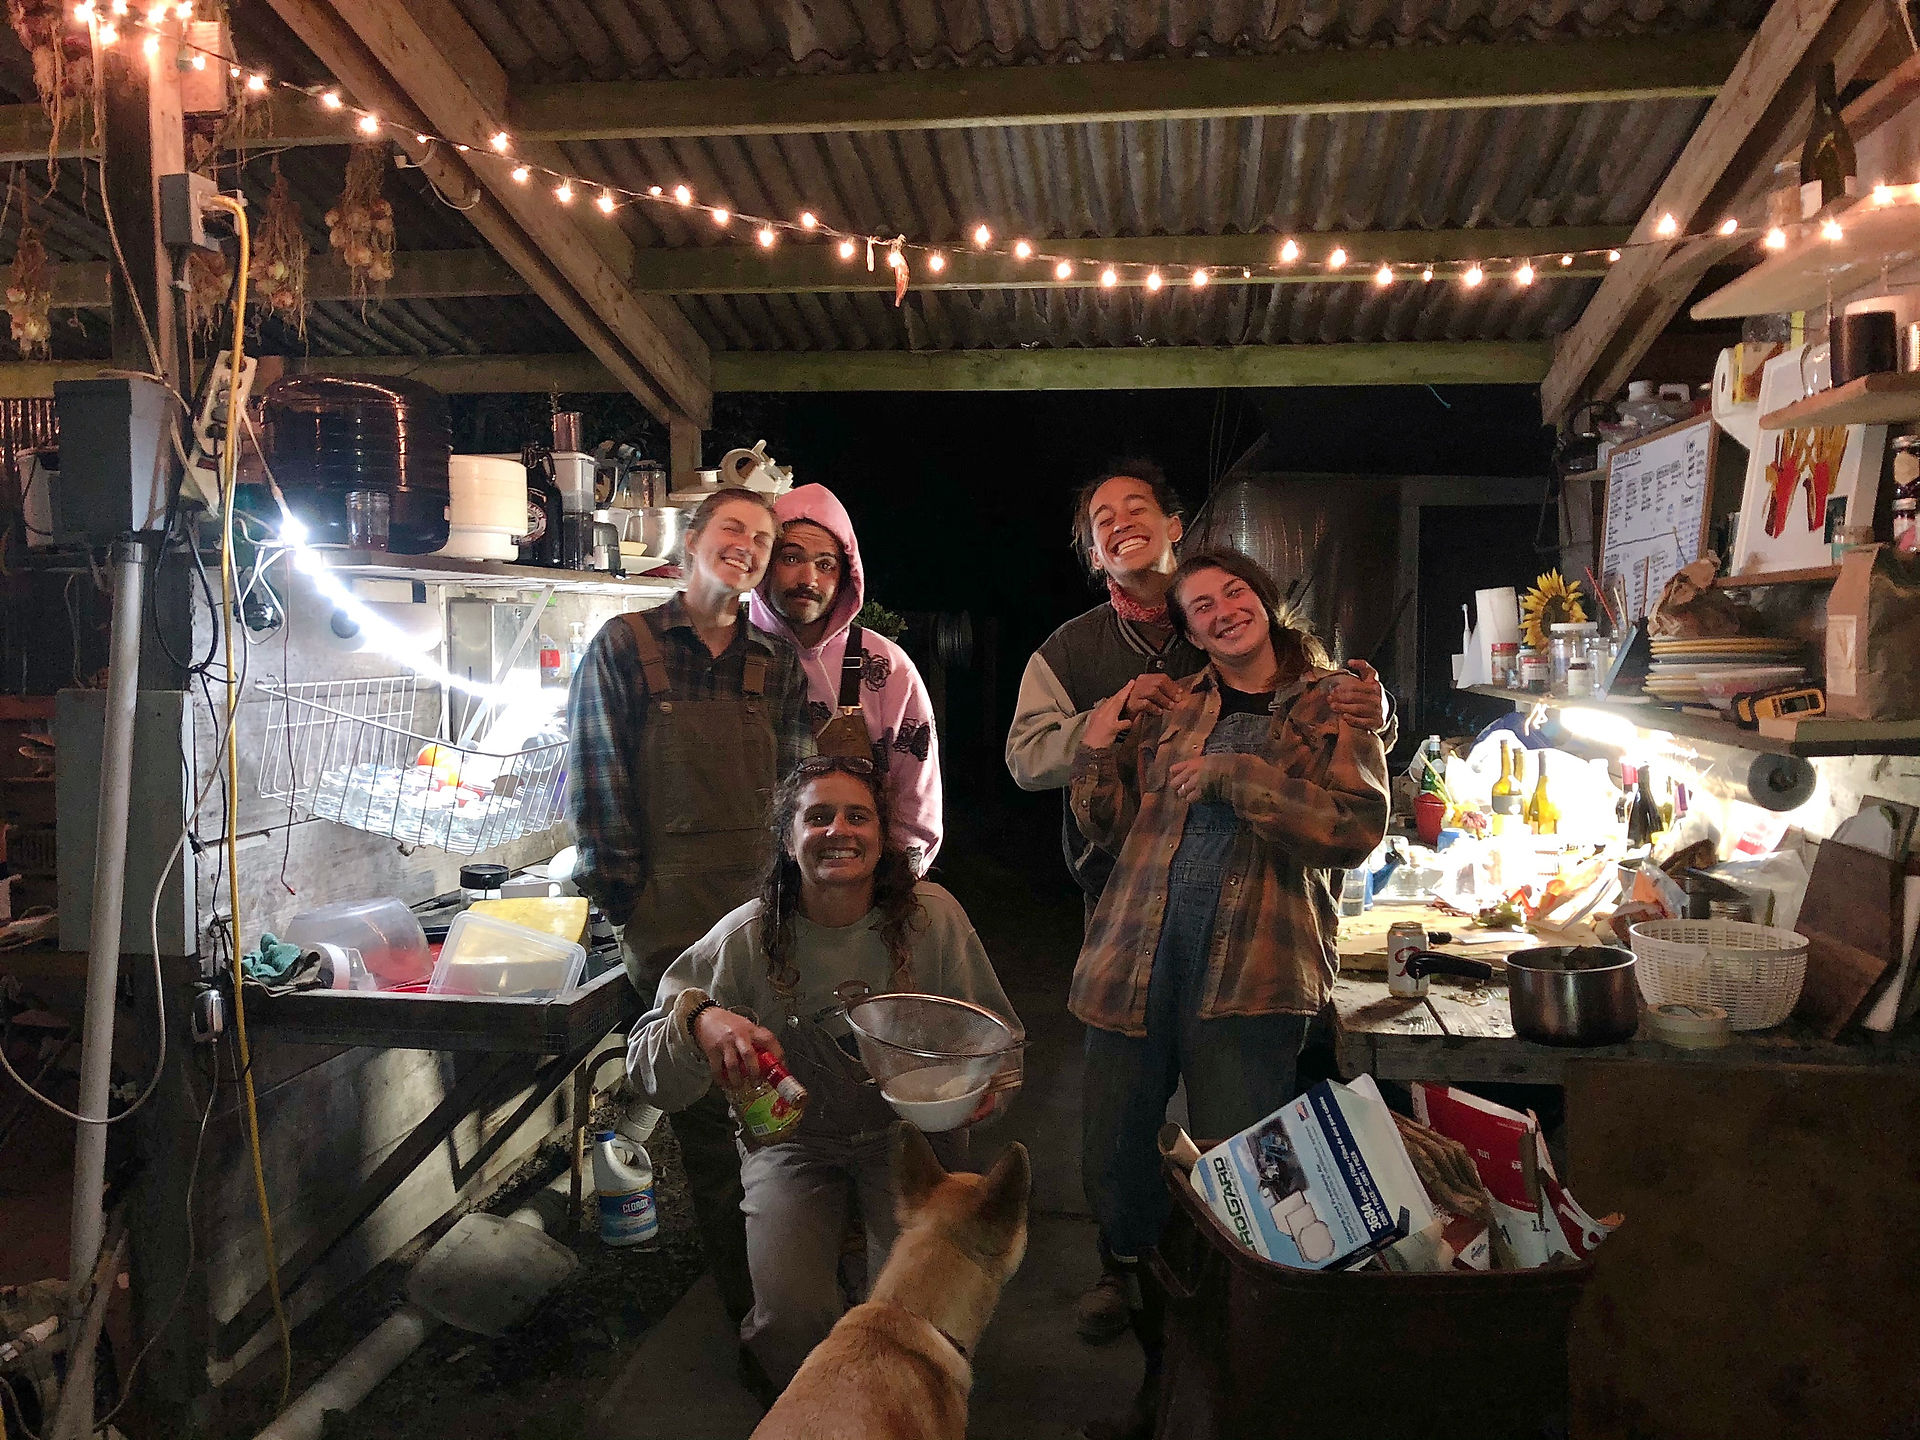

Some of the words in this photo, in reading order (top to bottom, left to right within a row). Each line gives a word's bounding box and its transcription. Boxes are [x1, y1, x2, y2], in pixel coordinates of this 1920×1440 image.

[1353, 1175, 1362, 1187] Air
[622, 1198, 649, 1213] CLOROX
[1213, 1157, 1258, 1254] ROGARD
[1359, 1200, 1383, 1233] 3684
